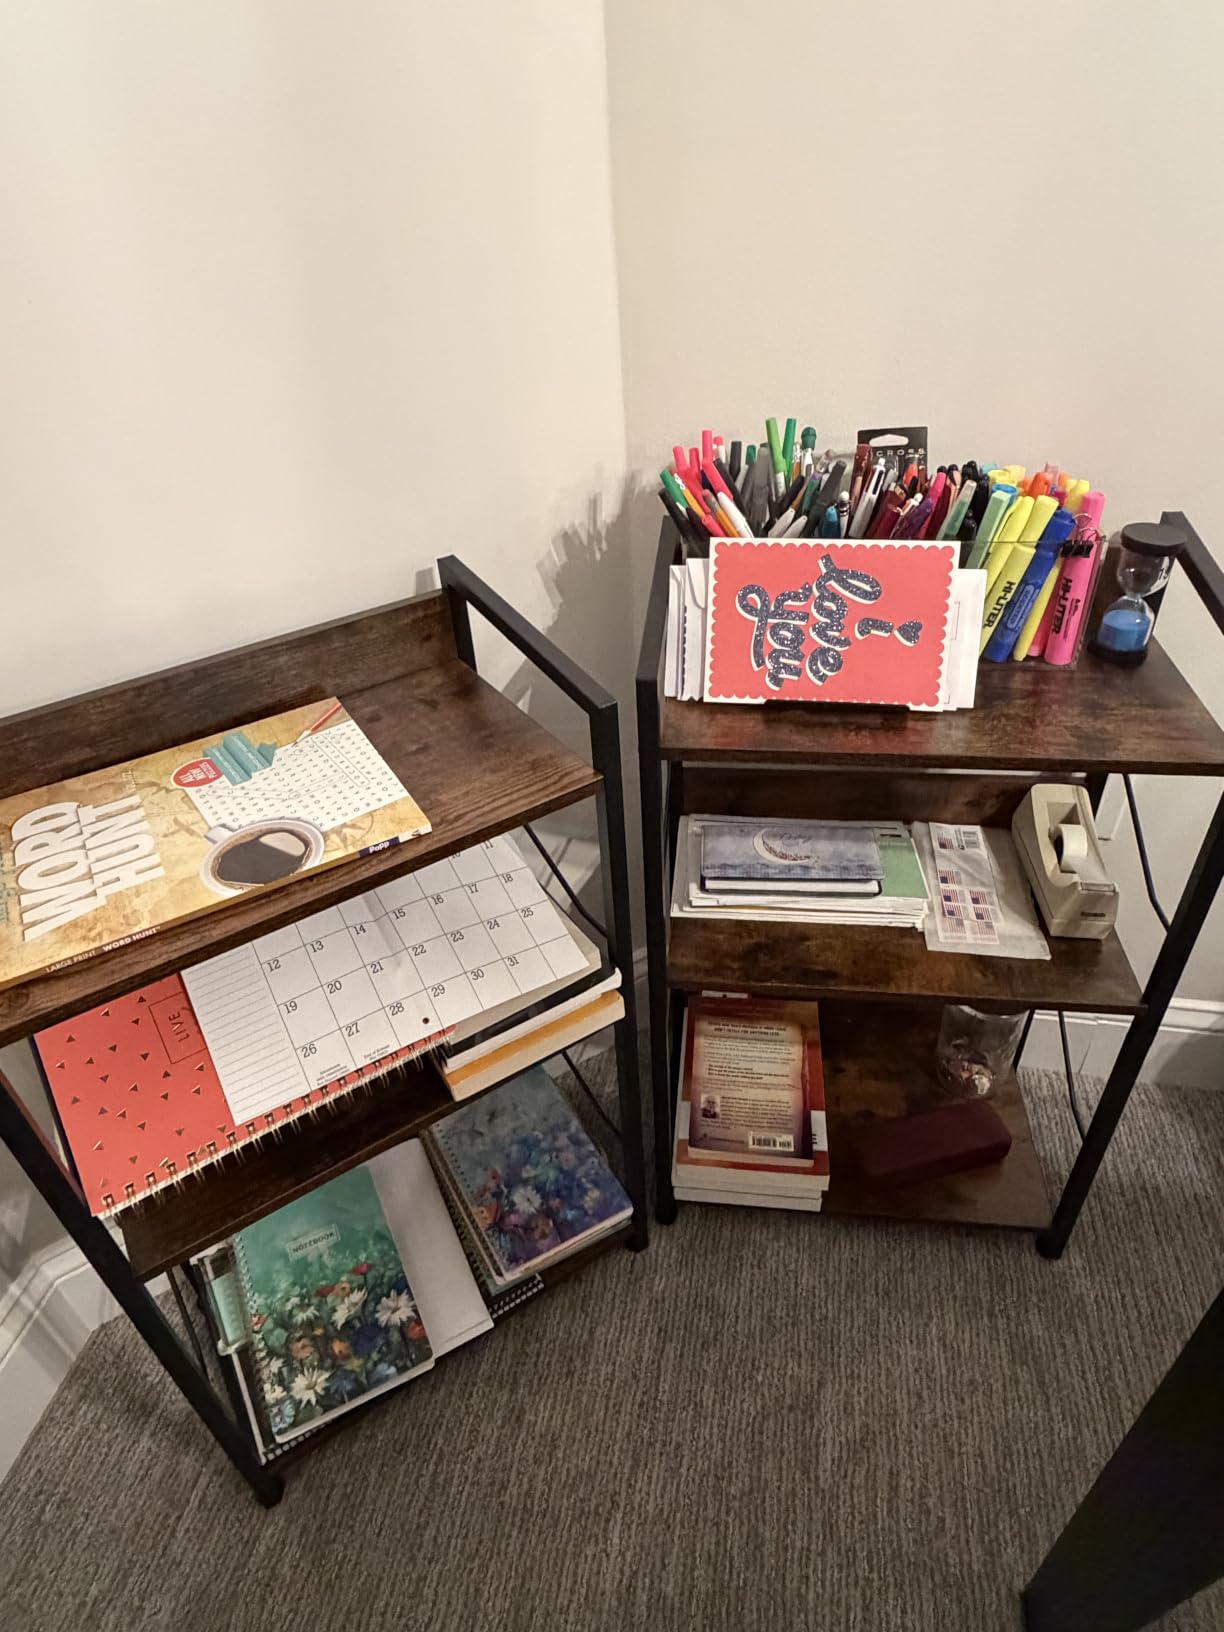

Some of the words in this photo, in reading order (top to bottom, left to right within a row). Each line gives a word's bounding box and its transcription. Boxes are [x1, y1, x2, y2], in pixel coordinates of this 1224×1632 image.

[805, 553, 882, 686] love
[736, 582, 813, 691] you
[77, 795, 166, 898] HUNT
[11, 802, 107, 942] WORD
[502, 874, 513, 884] 18
[468, 883, 479, 894] 17
[431, 895, 444, 905] 16
[393, 908, 406, 920] 15
[521, 907, 534, 918] 25
[353, 924, 366, 935] 14
[487, 919, 500, 930] 24
[450, 931, 465, 943] 23
[309, 941, 324, 952] 13
[411, 944, 427, 957] 22
[45, 959, 72, 973] LARGE
[73, 950, 97, 963] PRINT
[102, 938, 131, 952] WORD
[507, 956, 519, 967] 31
[266, 959, 281, 972] 12
[370, 961, 384, 974] 21
[470, 968, 485, 981] 30
[327, 980, 342, 994] 20
[431, 984, 446, 997] 29
[283, 1001, 298, 1014] 19
[389, 1002, 405, 1016] 28
[168, 1010, 190, 1042] LIVE
[345, 1022, 360, 1037] 27
[301, 1043, 317, 1058] 26
[291, 1232, 335, 1255] NOTEBOOK
